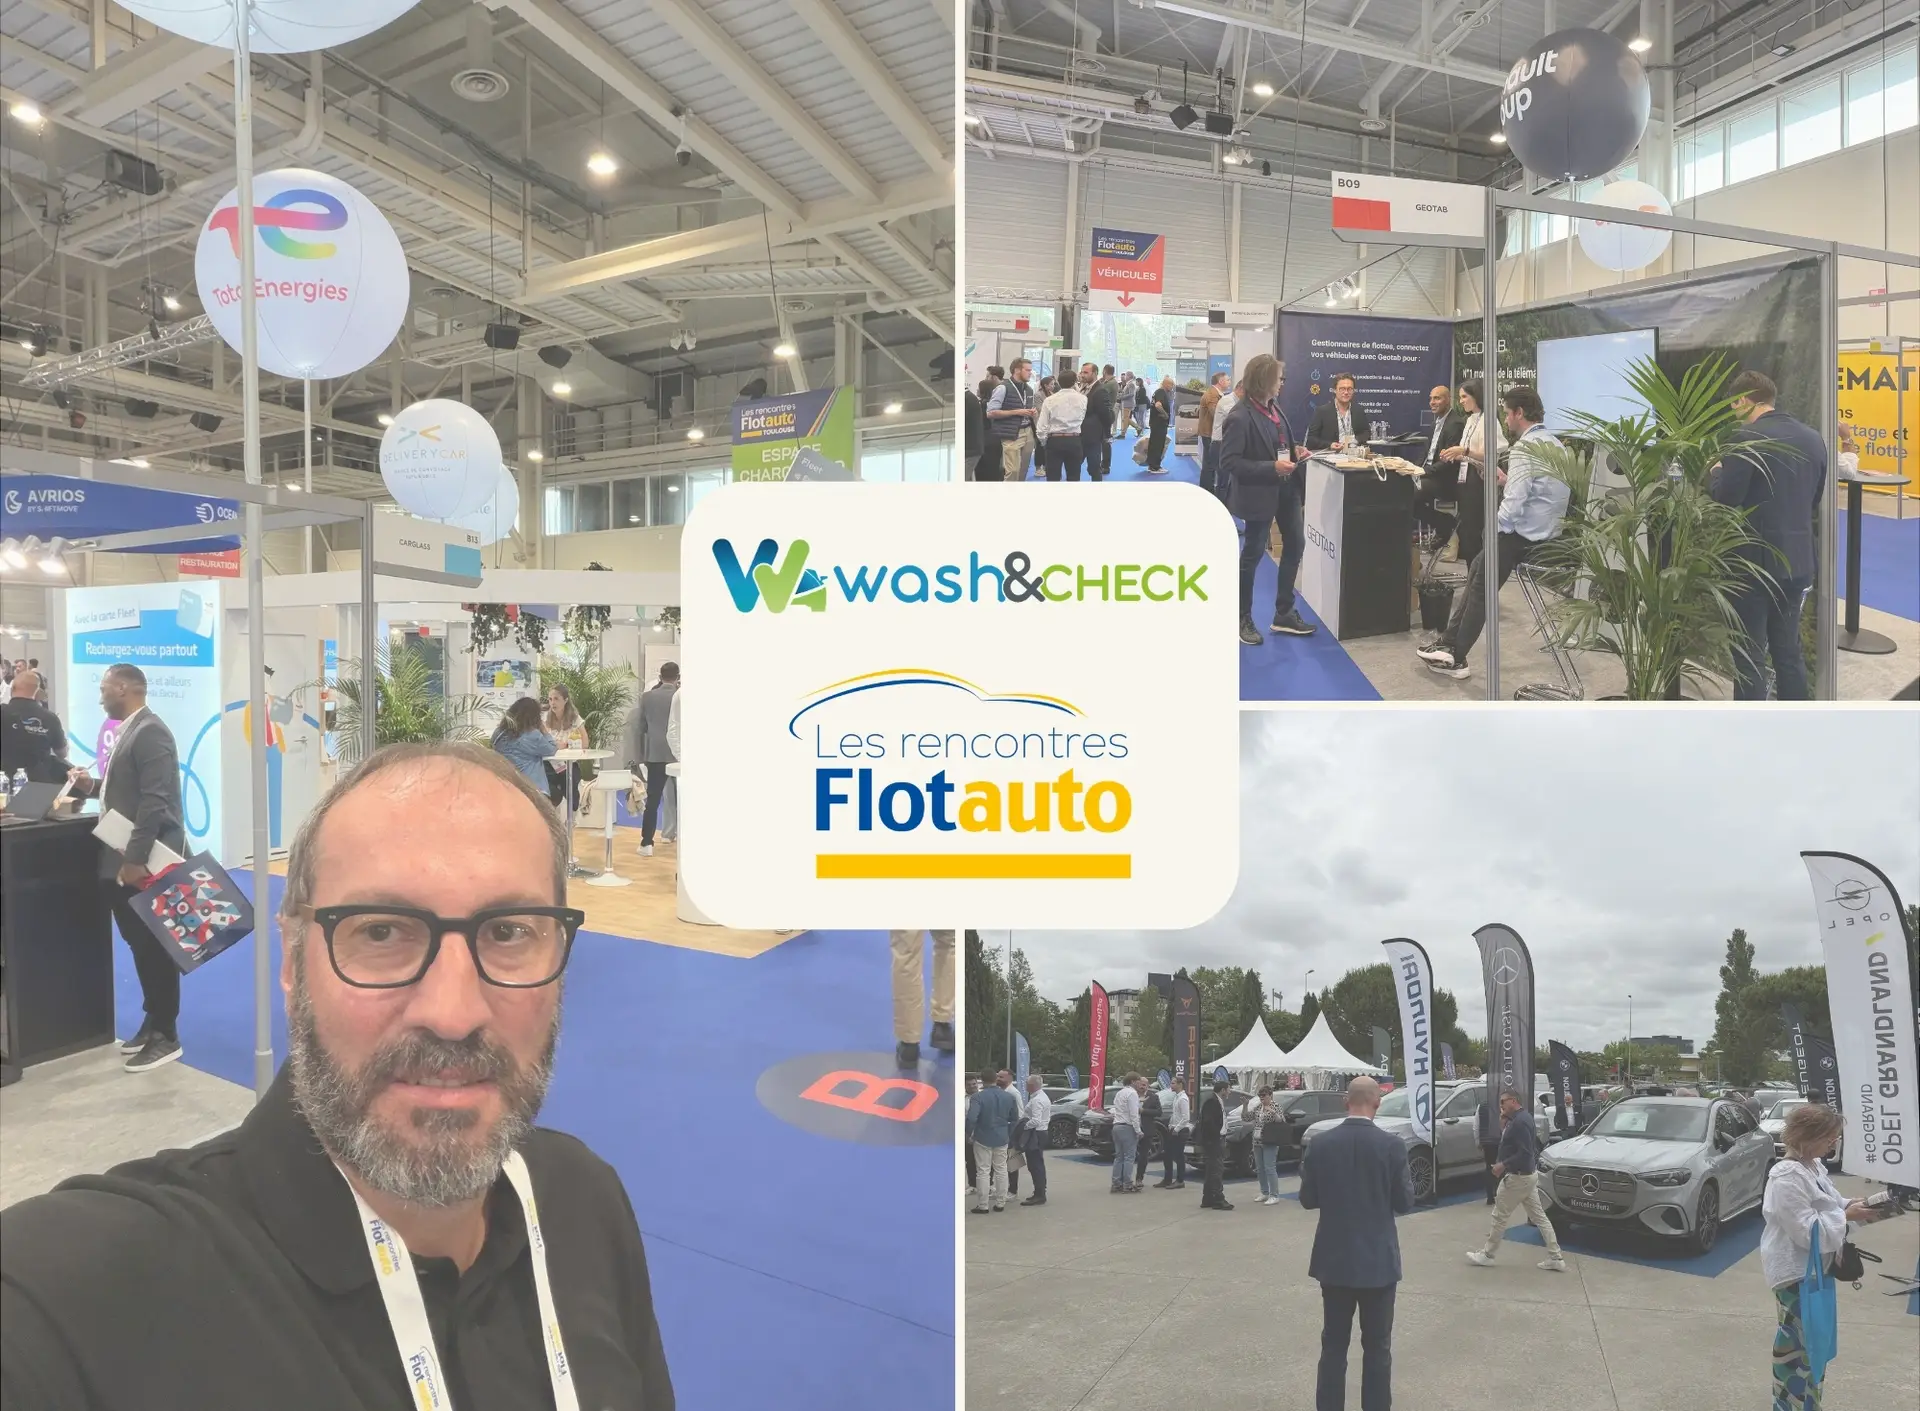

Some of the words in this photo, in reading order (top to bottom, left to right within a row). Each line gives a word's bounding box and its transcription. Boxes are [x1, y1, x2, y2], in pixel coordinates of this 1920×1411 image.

[1503, 50, 1558, 95] ault
[1338, 178, 1360, 189] B09
[1415, 203, 1448, 213] GEOTAB
[1097, 240, 1136, 251] Flotauto
[1097, 267, 1157, 281] VÉHICULES
[212, 278, 348, 306] TotEnergies
[1311, 339, 1360, 349] Gestionnaires
[1396, 343, 1430, 352] connectez
[1325, 351, 1359, 360] véhicules
[1377, 353, 1401, 362] Geotab
[1402, 355, 1417, 363] pour
[1837, 366, 1920, 391] EMAT
[741, 408, 755, 417] Les
[754, 403, 796, 416] rencontres
[741, 412, 797, 431] Flotauto
[1892, 426, 1909, 441] et
[801, 457, 823, 475] Fleet
[28, 489, 86, 503] AVRIOS
[398, 538, 431, 551] CARGLASS
[1306, 523, 1335, 560] GEOTAB
[180, 557, 239, 570] RESTAURATION
[117, 607, 136, 619] Fleet
[85, 641, 157, 658] Rechargez-vous
[159, 643, 198, 659] partout
[799, 1070, 939, 1122] B
